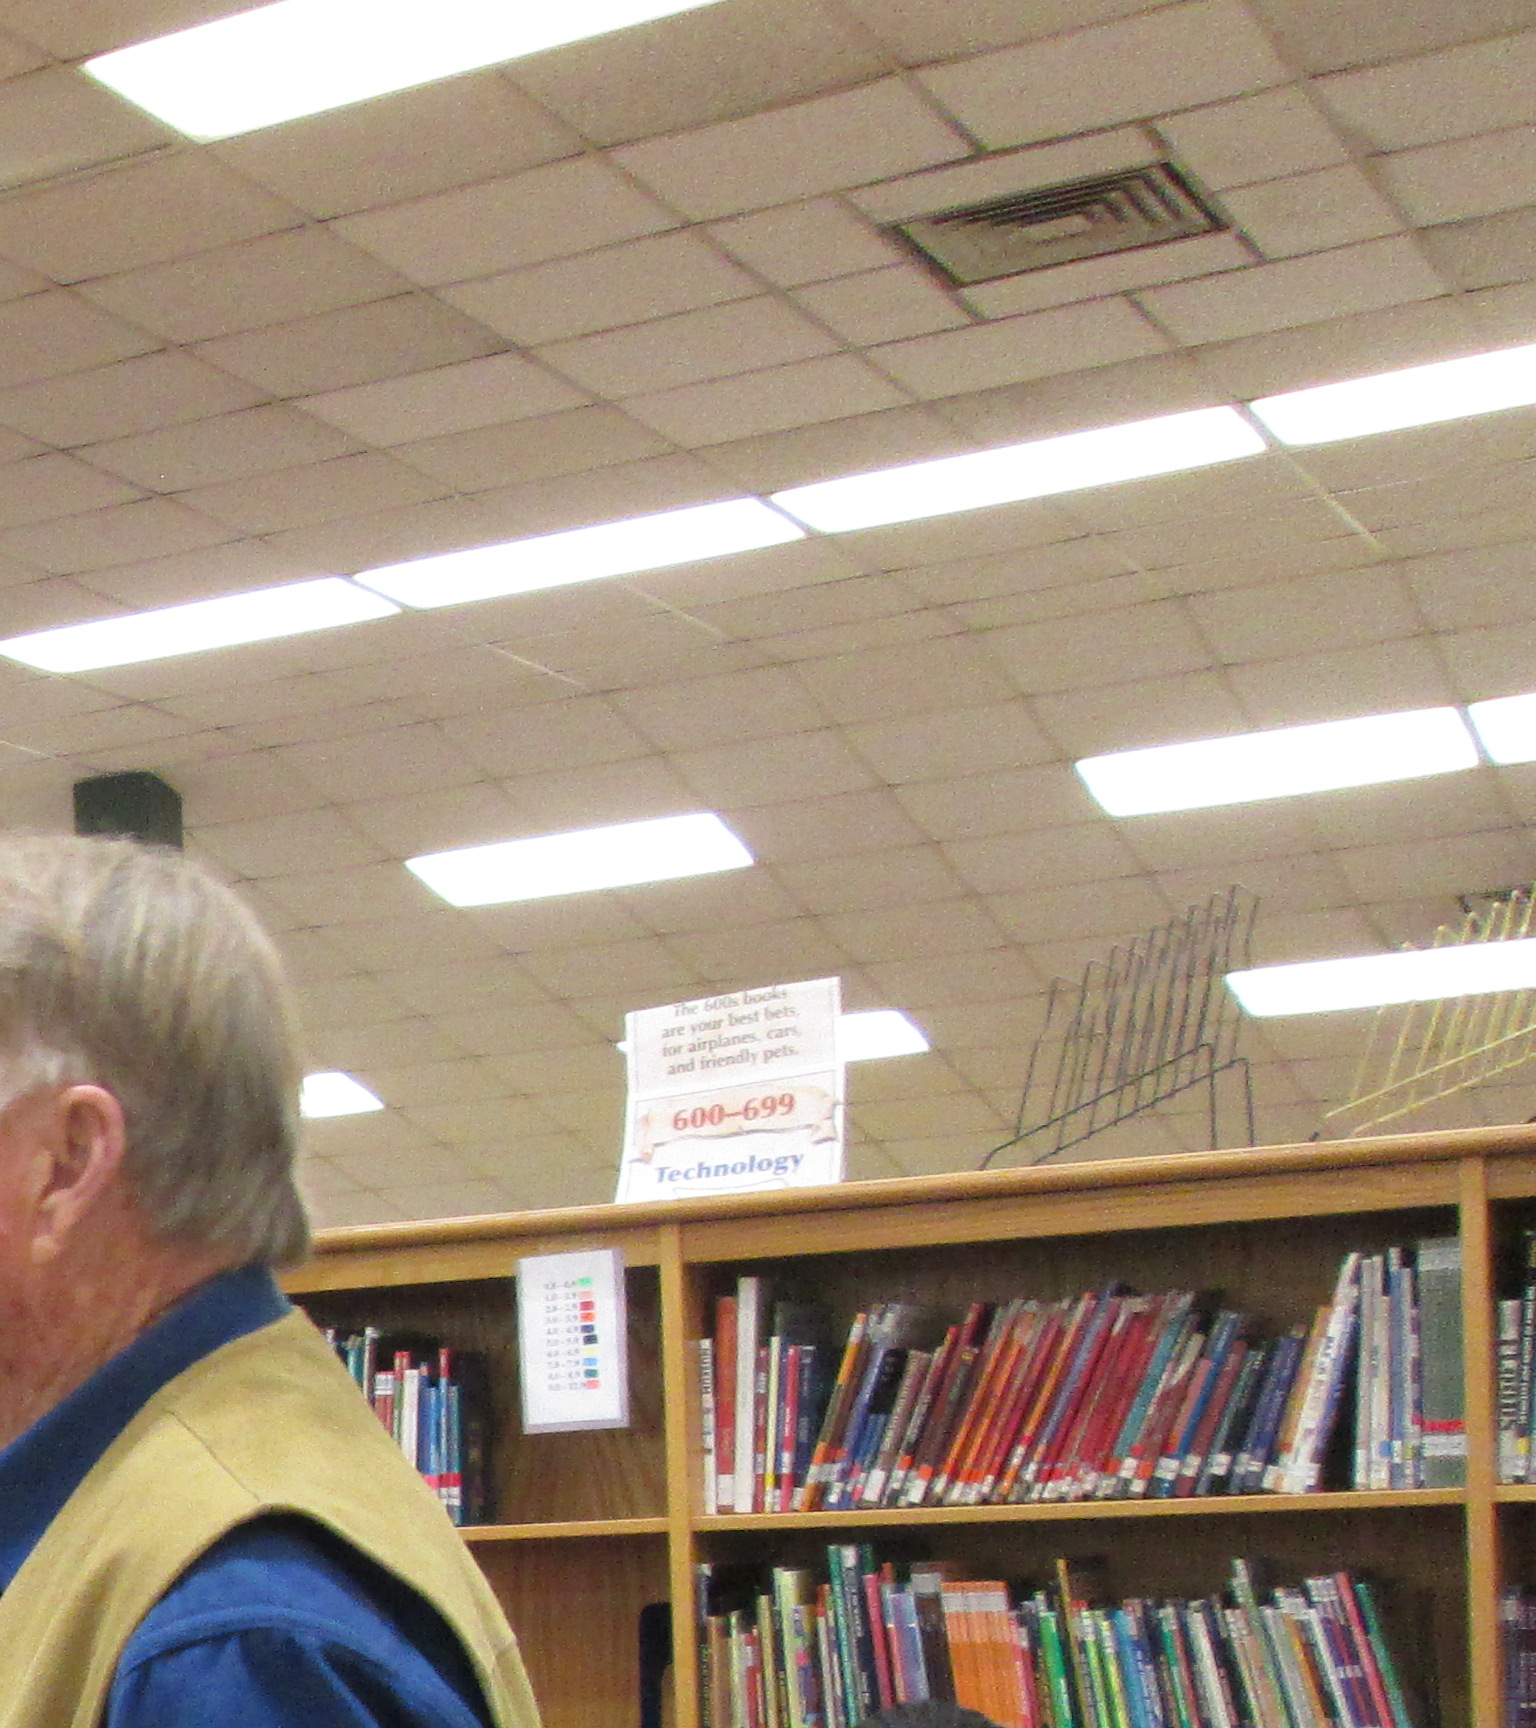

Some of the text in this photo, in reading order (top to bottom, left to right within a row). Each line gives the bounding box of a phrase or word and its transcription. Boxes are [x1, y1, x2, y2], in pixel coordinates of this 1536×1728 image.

[743, 987, 788, 1006] books
[661, 1023, 685, 1039] are
[690, 1017, 724, 1034] your
[728, 1010, 760, 1027] best
[661, 1043, 682, 1058] for
[667, 1060, 695, 1076] and
[700, 1049, 758, 1071] friendly
[656, 1153, 804, 1183] Technology
